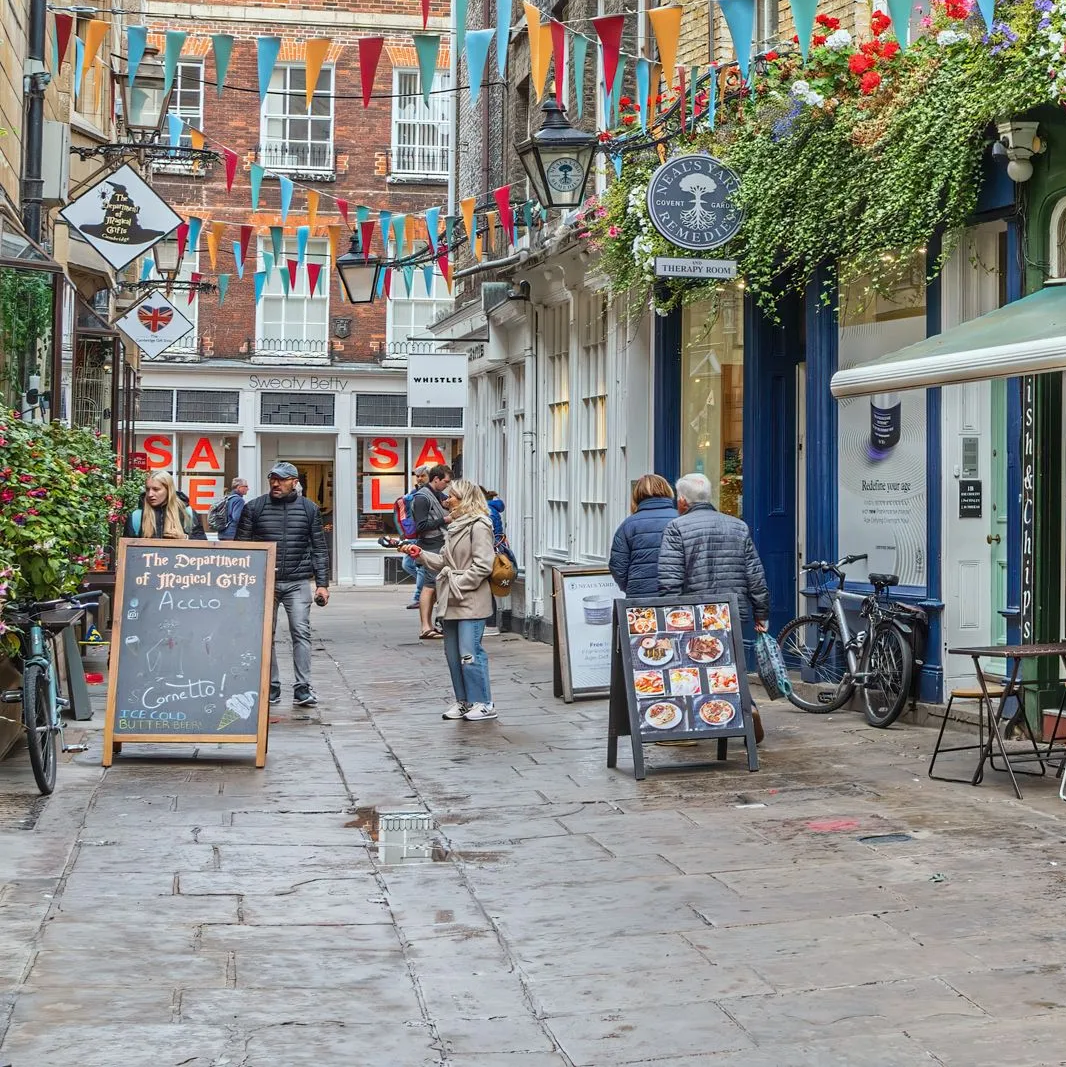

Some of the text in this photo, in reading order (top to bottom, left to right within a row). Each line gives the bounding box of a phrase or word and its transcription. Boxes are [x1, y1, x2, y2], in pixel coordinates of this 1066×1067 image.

[656, 160, 702, 196] NEAL'S
[115, 194, 129, 202] The
[660, 211, 738, 242] REMEDIES
[662, 264, 731, 275] THERAPY ROOM
[249, 375, 349, 392] Sweaty Betty
[1024, 377, 1034, 455] ish
[861, 480, 911, 493] Redefine your age
[143, 553, 251, 571] The Department
[136, 573, 256, 590] of Magical Gifts
[158, 591, 221, 611] Accio
[119, 709, 186, 720] ICE COLD
